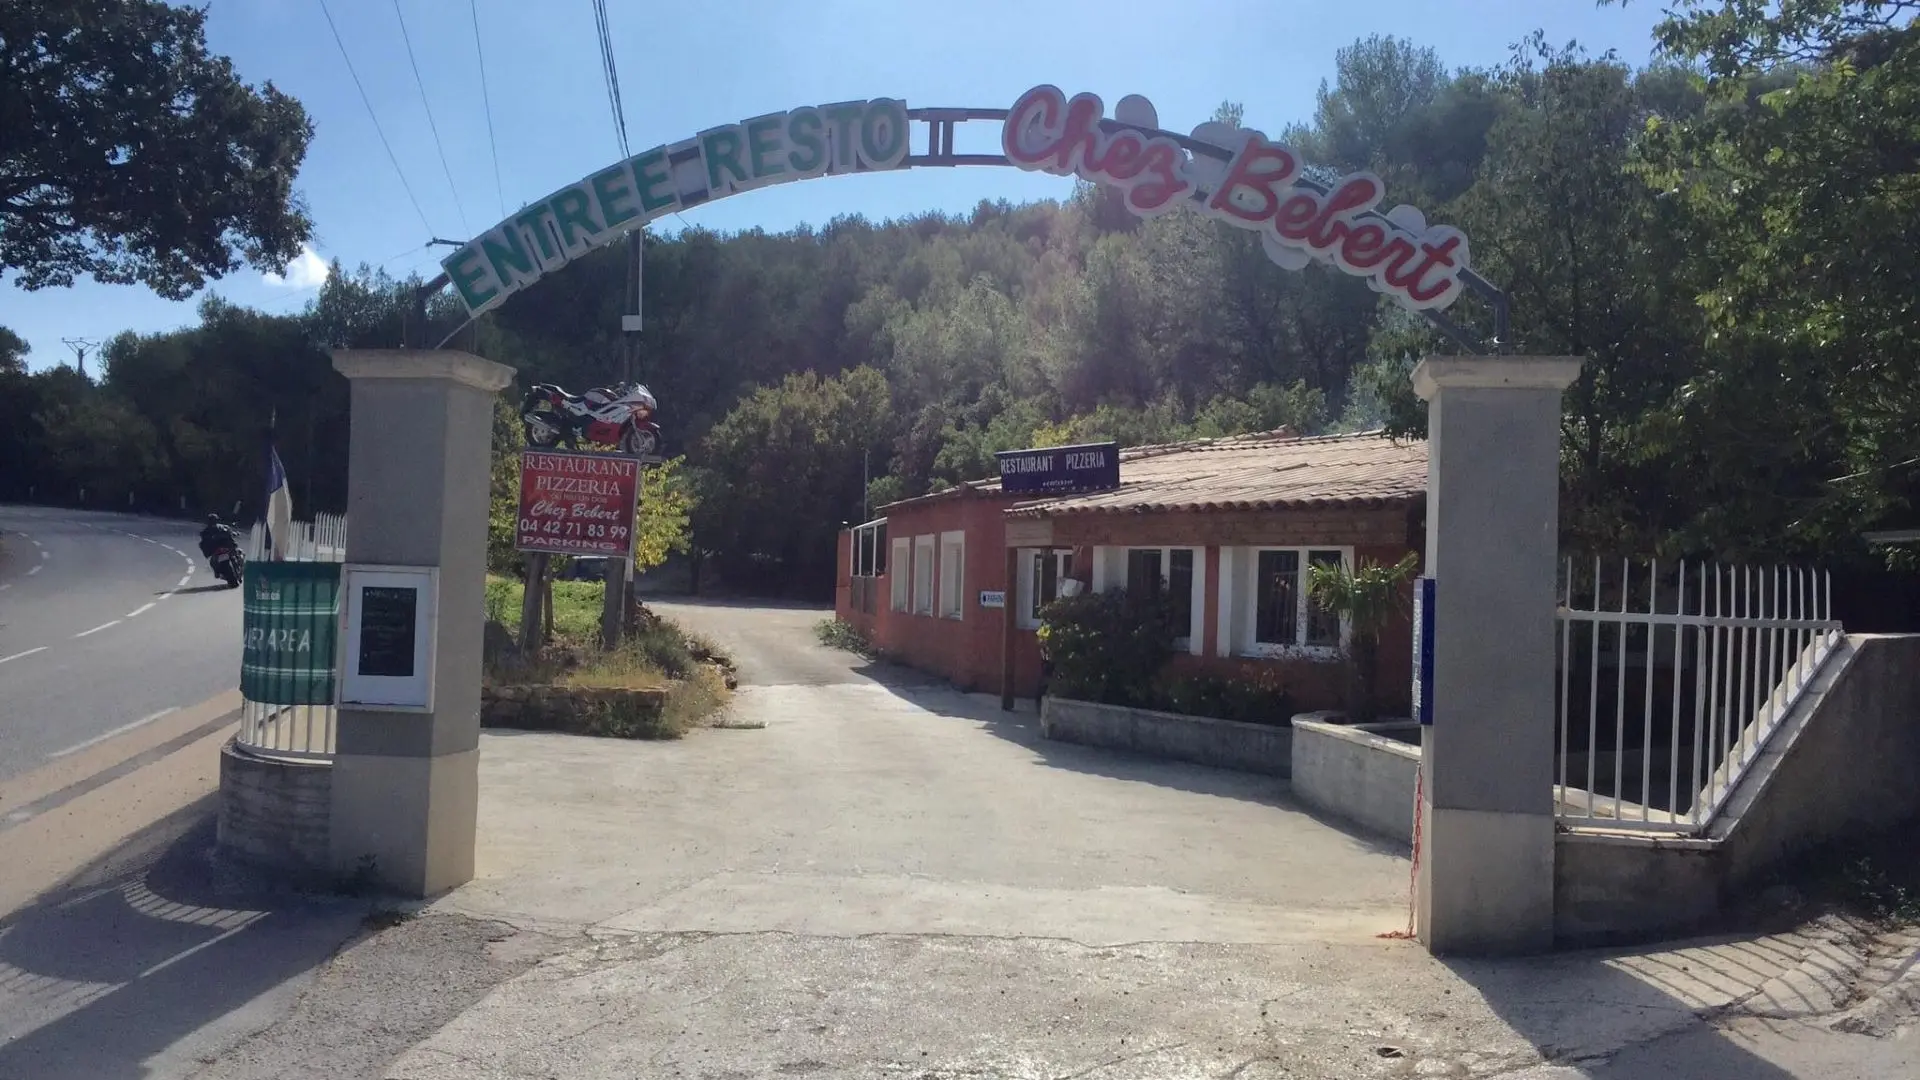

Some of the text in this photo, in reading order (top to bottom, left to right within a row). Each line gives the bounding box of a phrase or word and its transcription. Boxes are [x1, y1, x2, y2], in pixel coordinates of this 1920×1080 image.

[445, 88, 1461, 311] ENTREE RESTO Chez Bebert
[526, 455, 634, 477] RESTAURANT
[1000, 451, 1105, 473] RESTAURANT PIZZERIA
[536, 475, 620, 495] PIZZERIA
[530, 500, 620, 520] Chez Bebert
[520, 519, 628, 539] 04 42 71 83 99
[522, 536, 617, 549] PARKING
